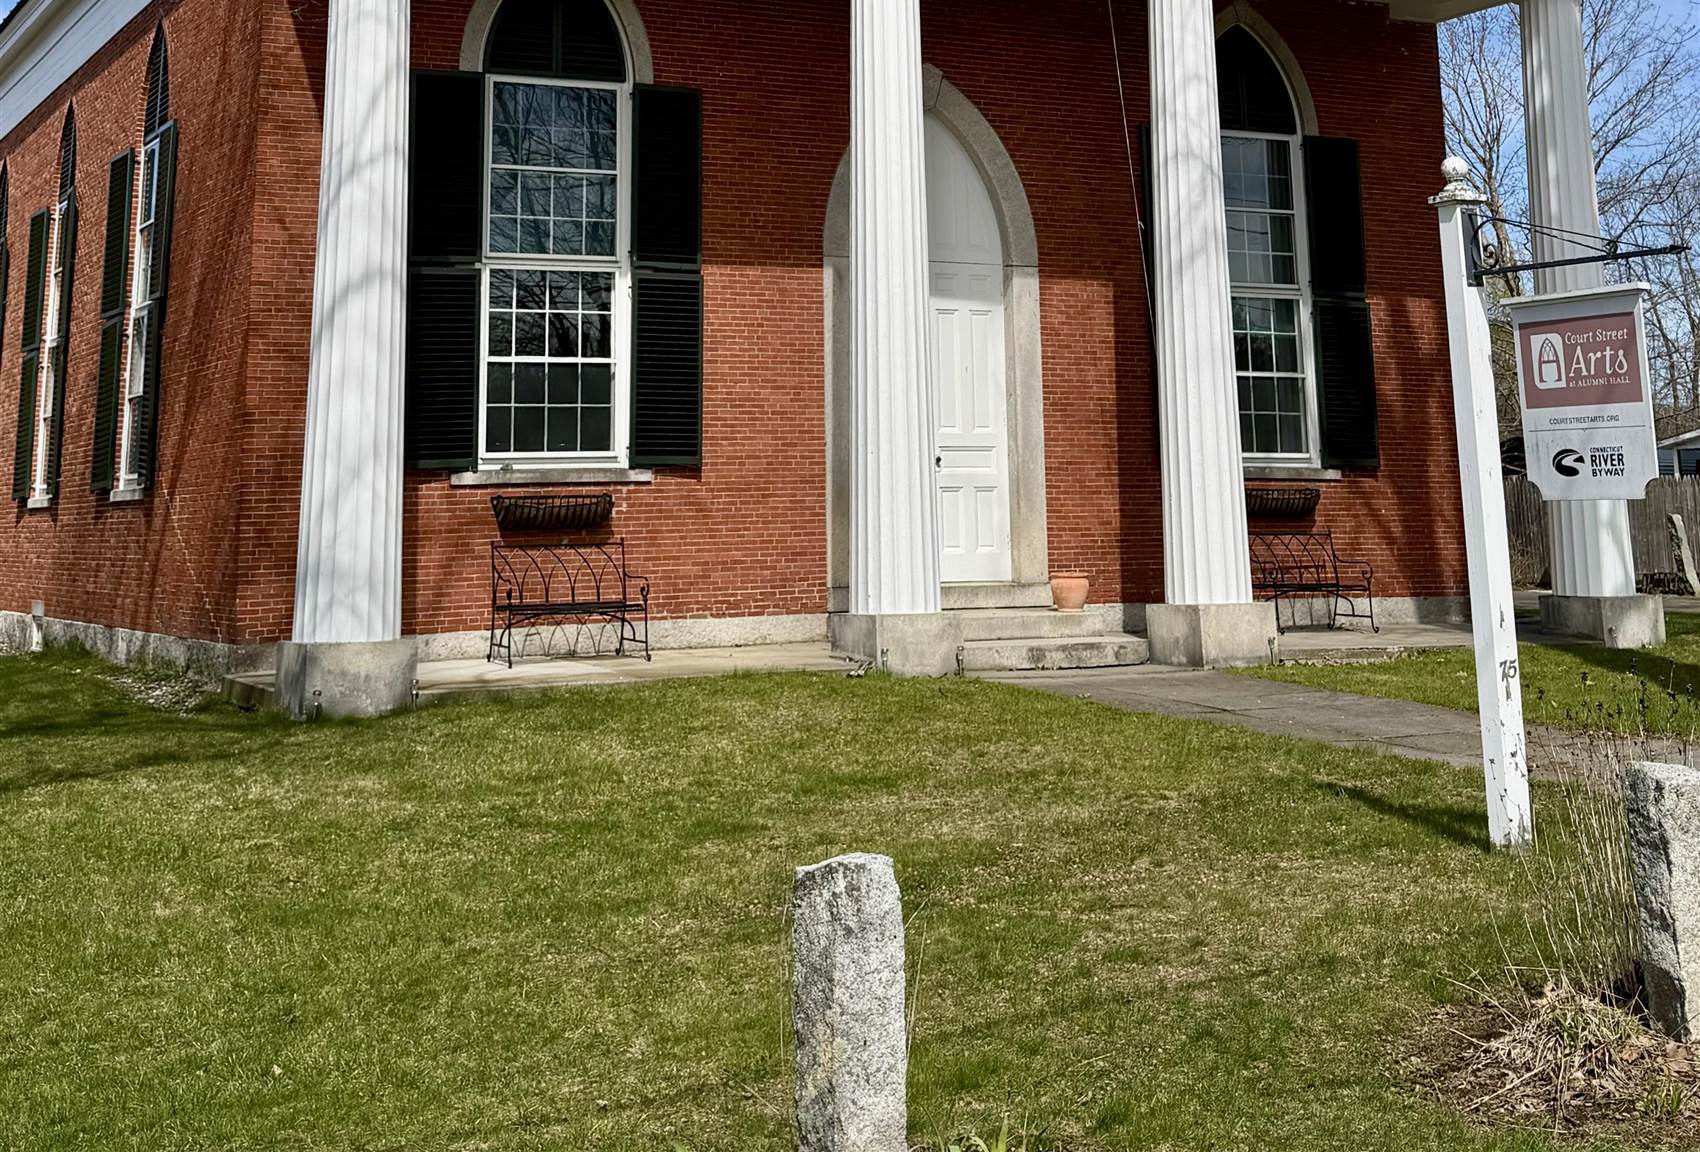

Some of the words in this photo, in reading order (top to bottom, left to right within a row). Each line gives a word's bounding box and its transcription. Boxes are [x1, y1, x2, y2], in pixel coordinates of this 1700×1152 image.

[1565, 331, 1594, 345] Court
[1596, 328, 1628, 341] Street
[1568, 345, 1629, 377] Arts
[1576, 378, 1608, 388] ALUMNI
[1610, 376, 1632, 385] HALL
[1549, 415, 1620, 425] COURTSTREETARTS.ORG
[1590, 453, 1625, 467] RIVER
[1591, 467, 1625, 478] BYWAY
